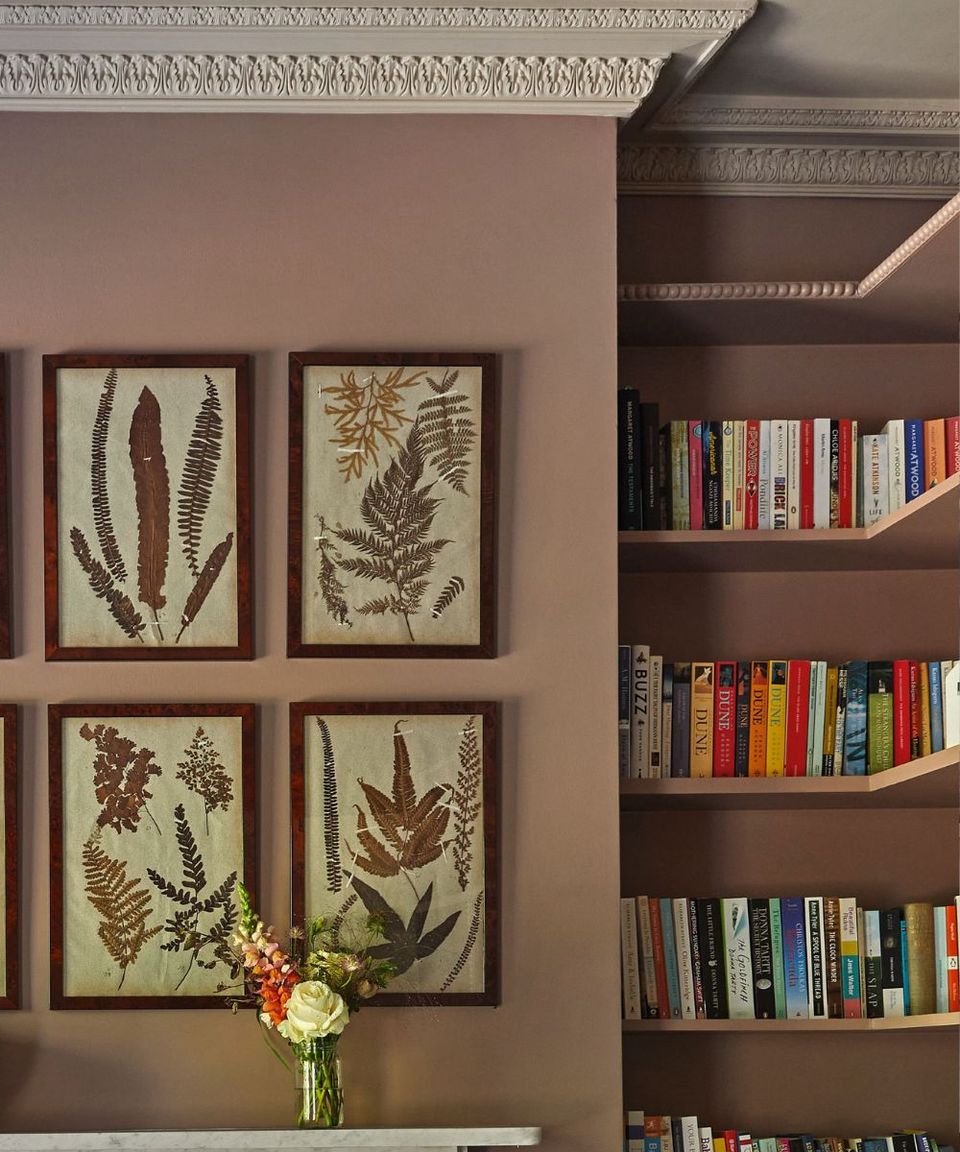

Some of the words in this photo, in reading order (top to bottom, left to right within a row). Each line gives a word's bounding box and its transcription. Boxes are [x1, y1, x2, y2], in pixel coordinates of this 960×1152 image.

[747, 430, 758, 476] POWER
[911, 453, 919, 496] ATWOOD
[760, 479, 768, 519] Pondlife
[774, 477, 785, 510] BRICK
[634, 670, 647, 715] BUZZ
[719, 690, 730, 731] DUNE
[753, 690, 763, 725] DUNE
[771, 688, 782, 727] DUNE
[695, 709, 707, 756] DUNE
[740, 704, 748, 728] DUNE
[758, 908, 769, 941] DONNA
[795, 922, 803, 957] CHRISTOS
[761, 944, 770, 974] TARTT
[868, 977, 877, 1007] SLAP
